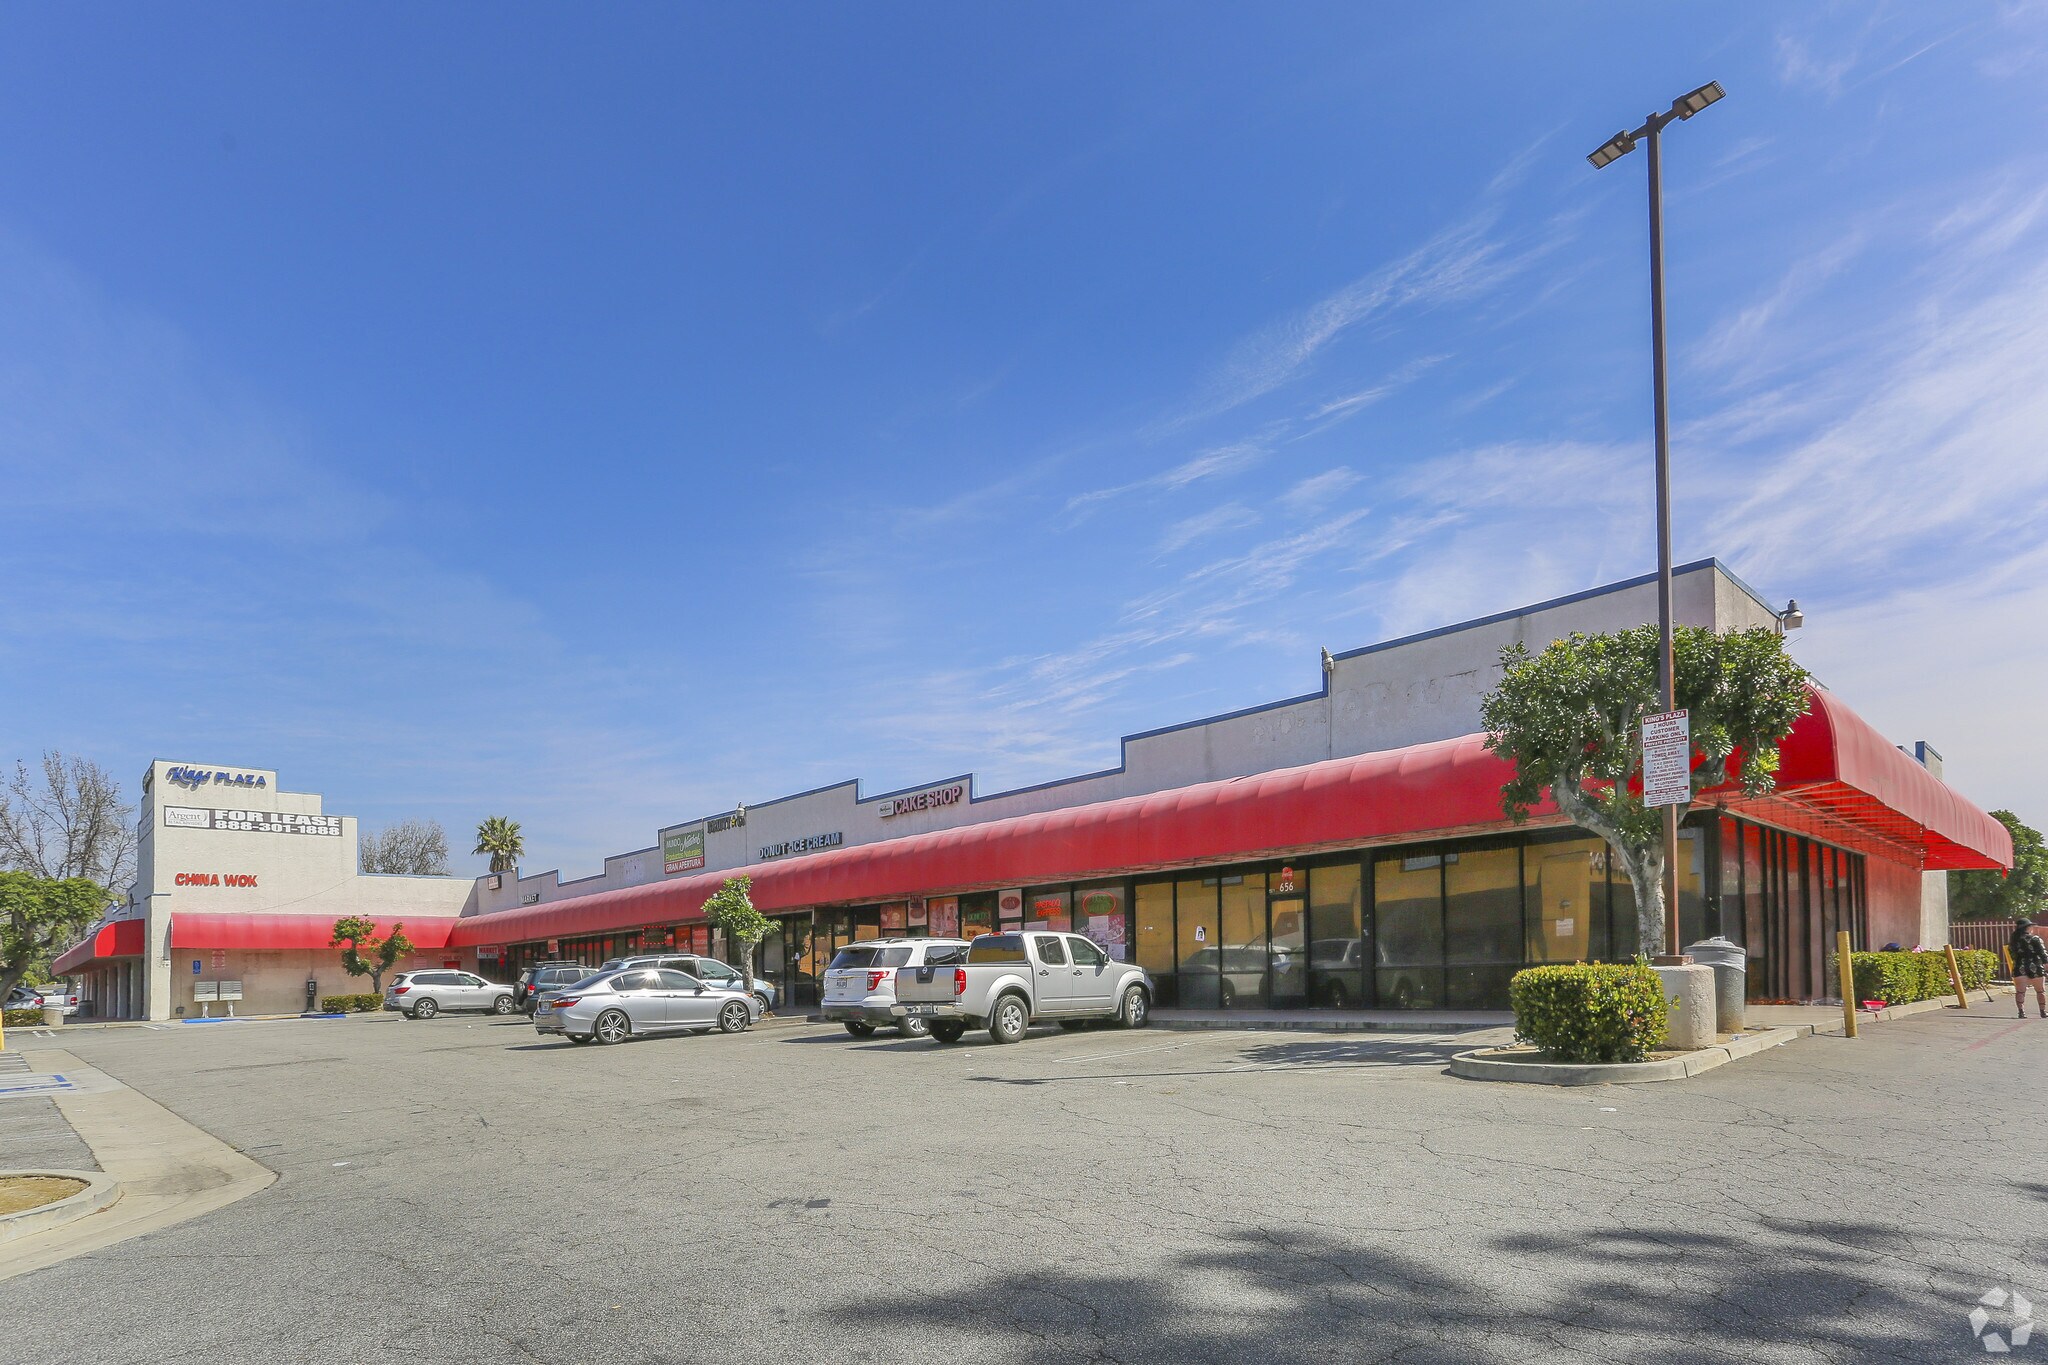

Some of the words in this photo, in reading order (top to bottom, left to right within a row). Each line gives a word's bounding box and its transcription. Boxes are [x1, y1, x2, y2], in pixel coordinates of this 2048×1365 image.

[1644, 715, 1665, 723] KING'S
[1665, 711, 1685, 720] PLAZA
[1657, 720, 1677, 728] HOURS
[1650, 726, 1680, 735] CUSTOMER
[1645, 733, 1669, 741] PARKING
[214, 771, 267, 789] PLAZA
[893, 794, 928, 814] CAKE
[926, 786, 963, 807] SHOP
[168, 811, 201, 822] Argent
[214, 809, 264, 822] FOR
[270, 812, 340, 827] LEASE
[214, 820, 340, 836] 888-301-1888
[758, 844, 787, 858] DONUT
[806, 832, 841, 848] CREAM
[665, 862, 679, 872] GRAN
[175, 873, 220, 886] CHINA
[223, 874, 258, 887] WOK
[1279, 881, 1294, 893] 656
[521, 893, 539, 904] MARKET
